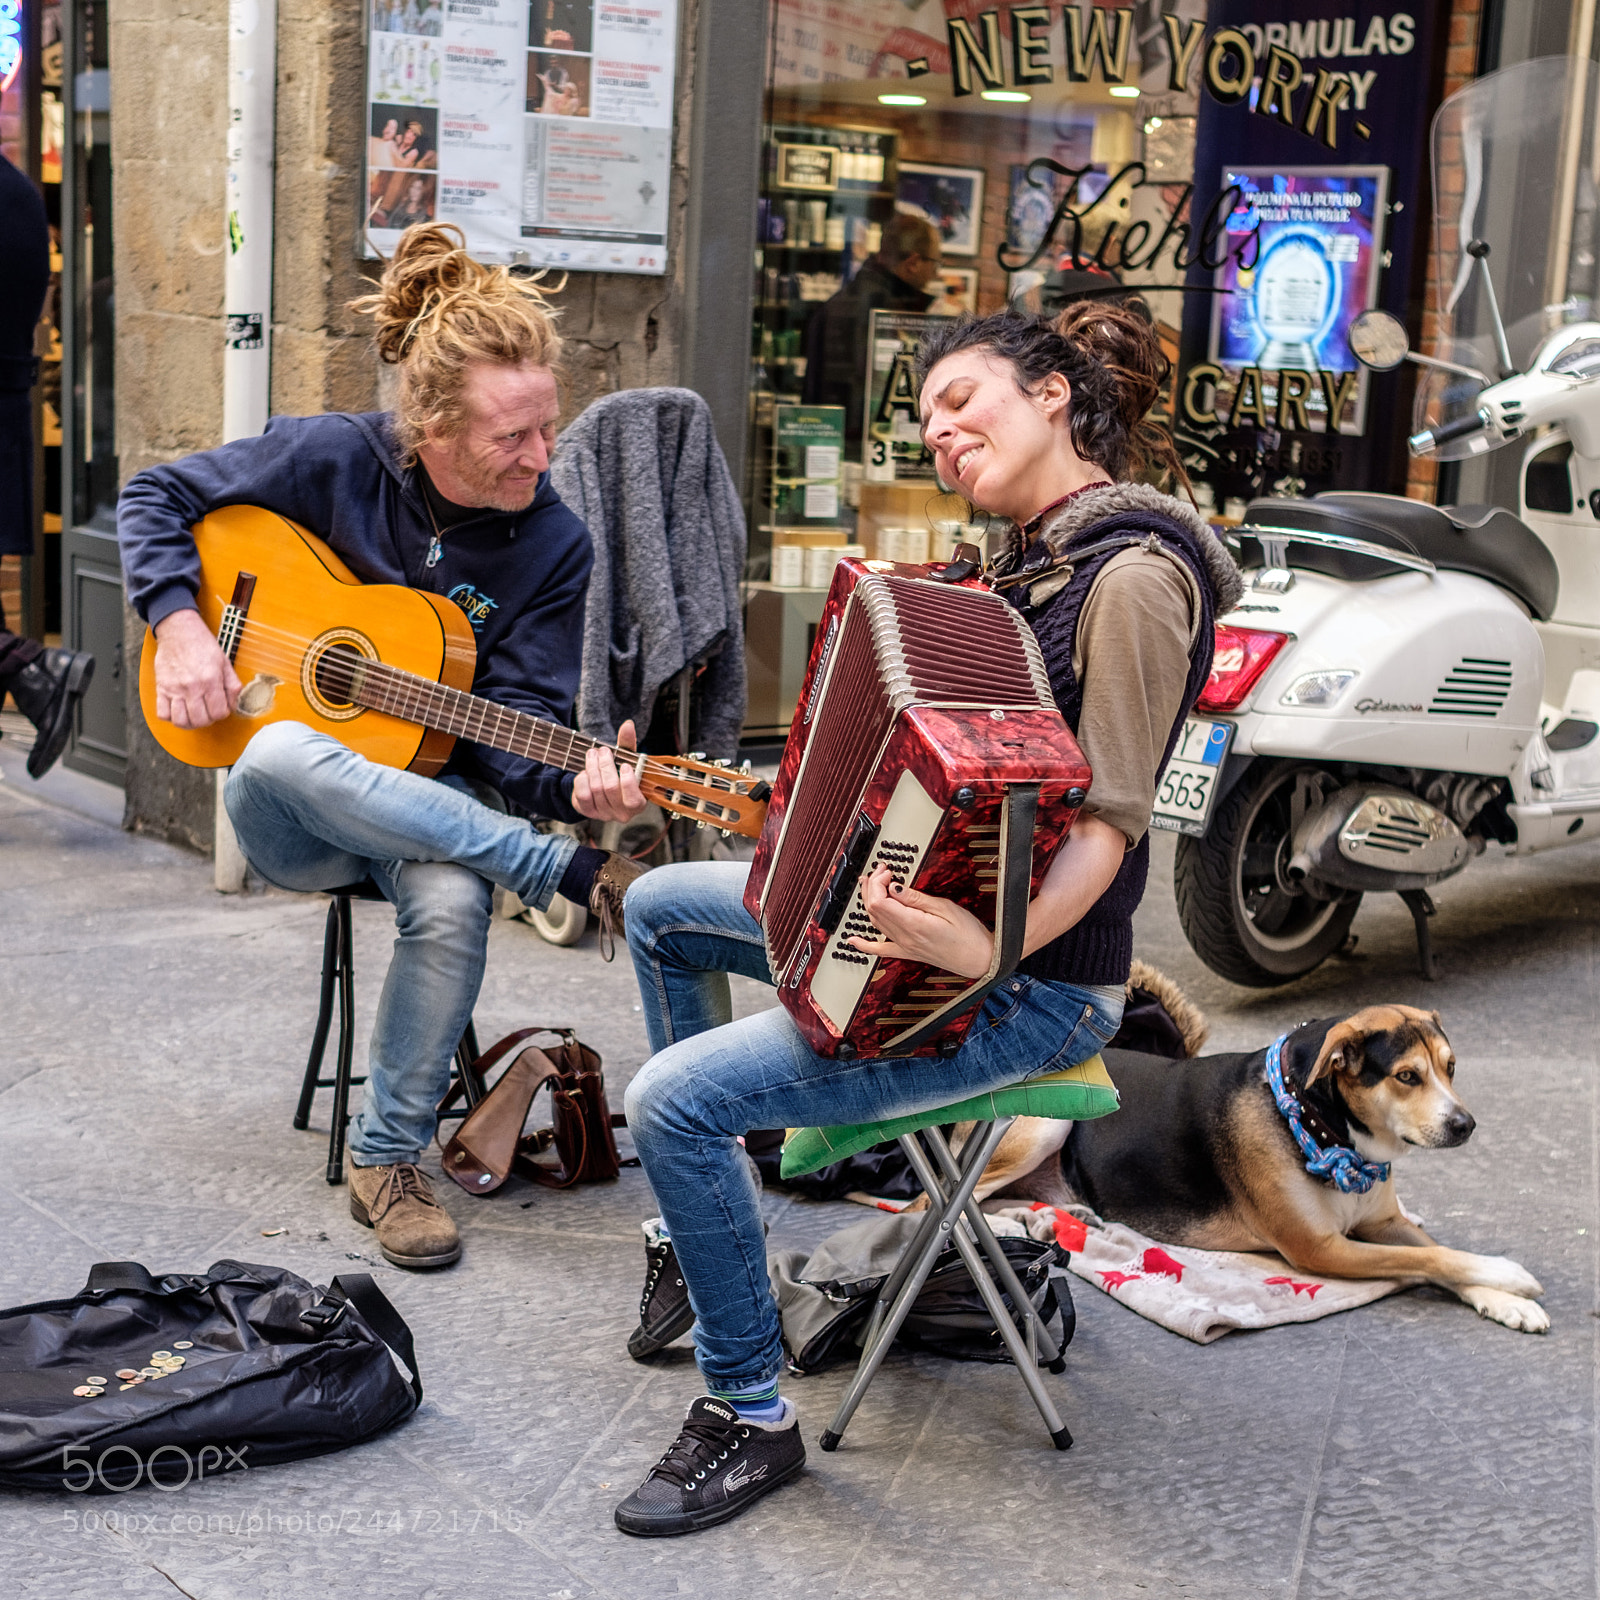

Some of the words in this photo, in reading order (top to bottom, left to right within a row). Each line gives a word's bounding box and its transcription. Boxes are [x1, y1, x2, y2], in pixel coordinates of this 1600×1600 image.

[1238, 13, 1416, 59] ORMULAS
[1159, 769, 1211, 811] 563
[703, 1402, 734, 1421] LACOSTE
